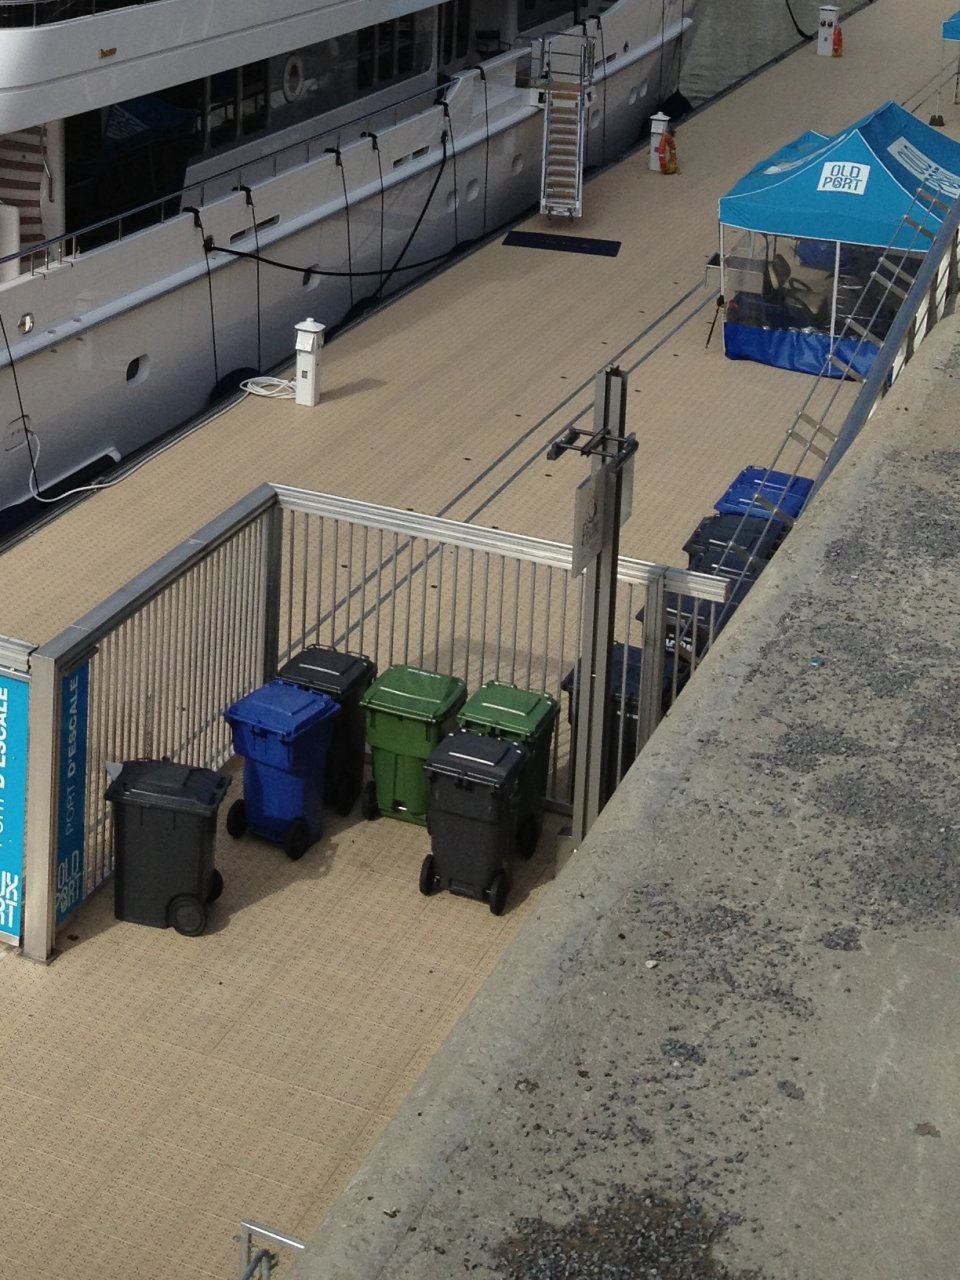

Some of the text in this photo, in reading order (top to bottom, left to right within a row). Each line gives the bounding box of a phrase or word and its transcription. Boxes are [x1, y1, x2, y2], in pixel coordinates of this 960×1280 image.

[830, 164, 861, 179] OLD
[822, 176, 863, 191] PORT
[64, 675, 79, 836] PORT D'ESCALE
